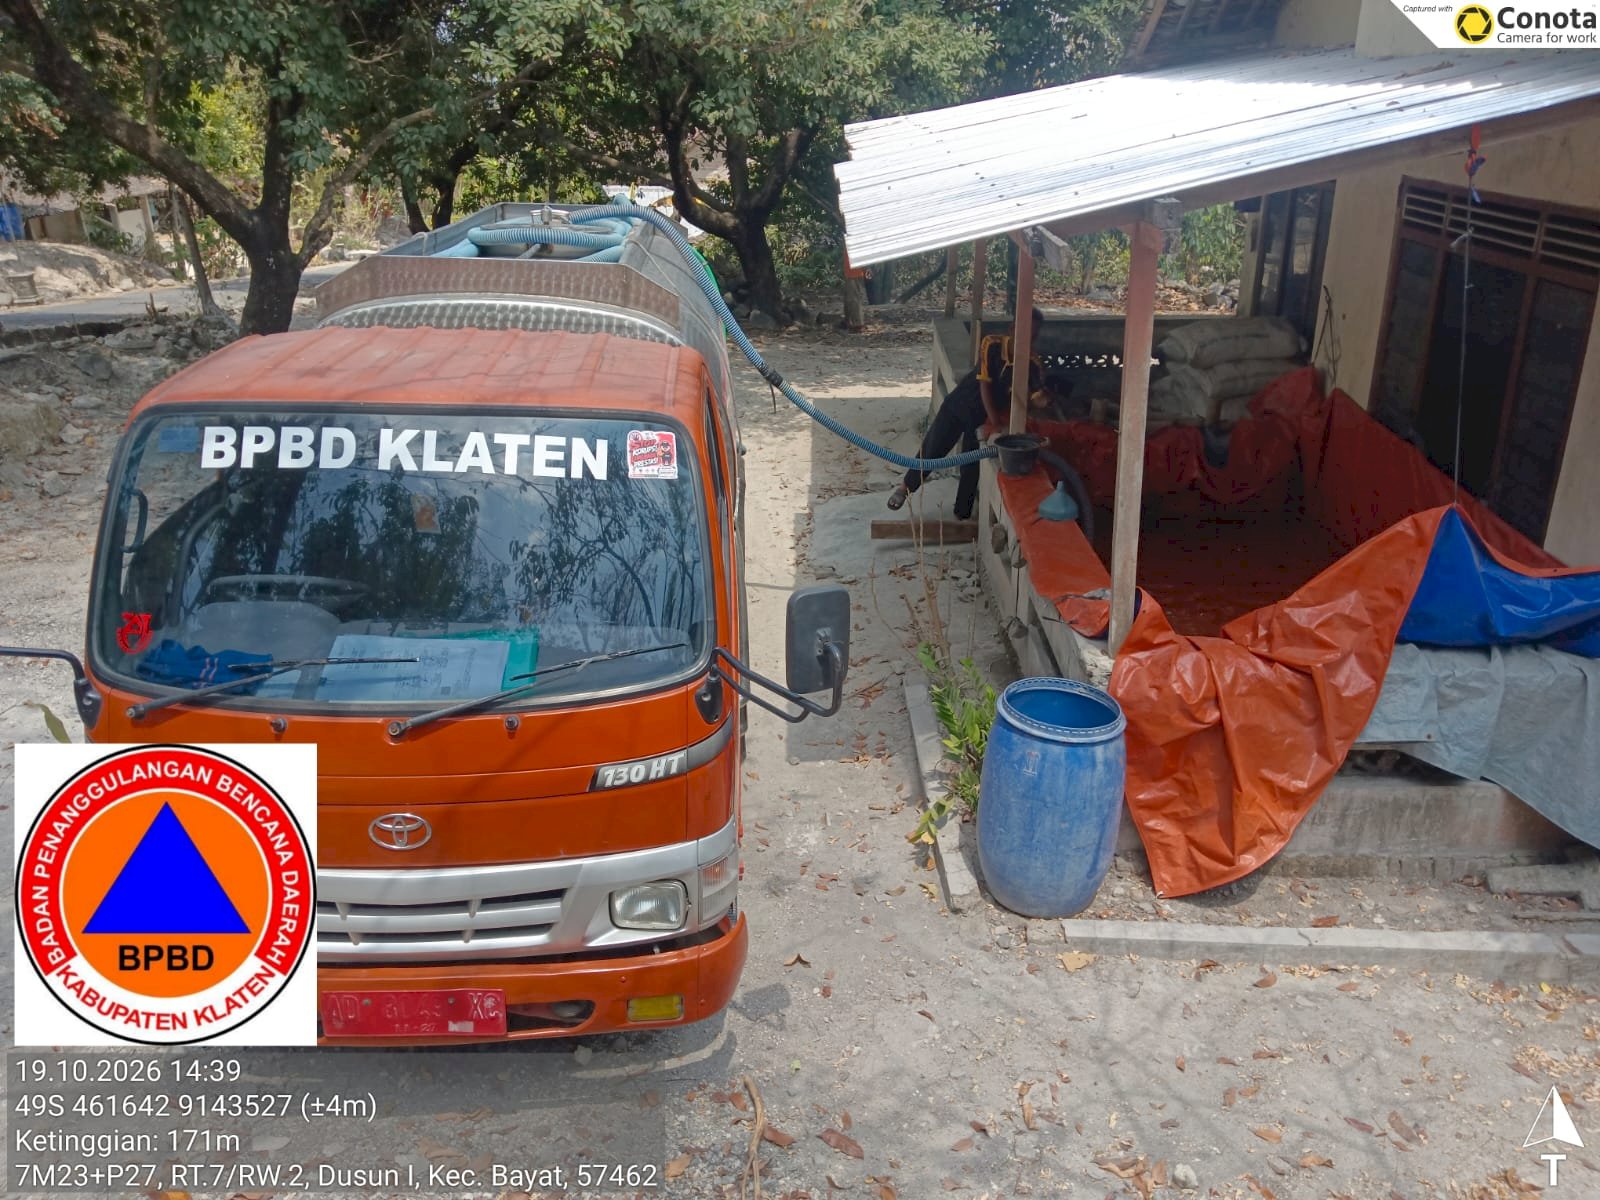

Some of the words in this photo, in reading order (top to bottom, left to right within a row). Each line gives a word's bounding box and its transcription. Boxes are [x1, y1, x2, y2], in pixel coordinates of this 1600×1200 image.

[201, 426, 356, 469] BPBD
[378, 428, 609, 481] KLATEN
[603, 764, 646, 788] 130
[648, 752, 685, 781] HT
